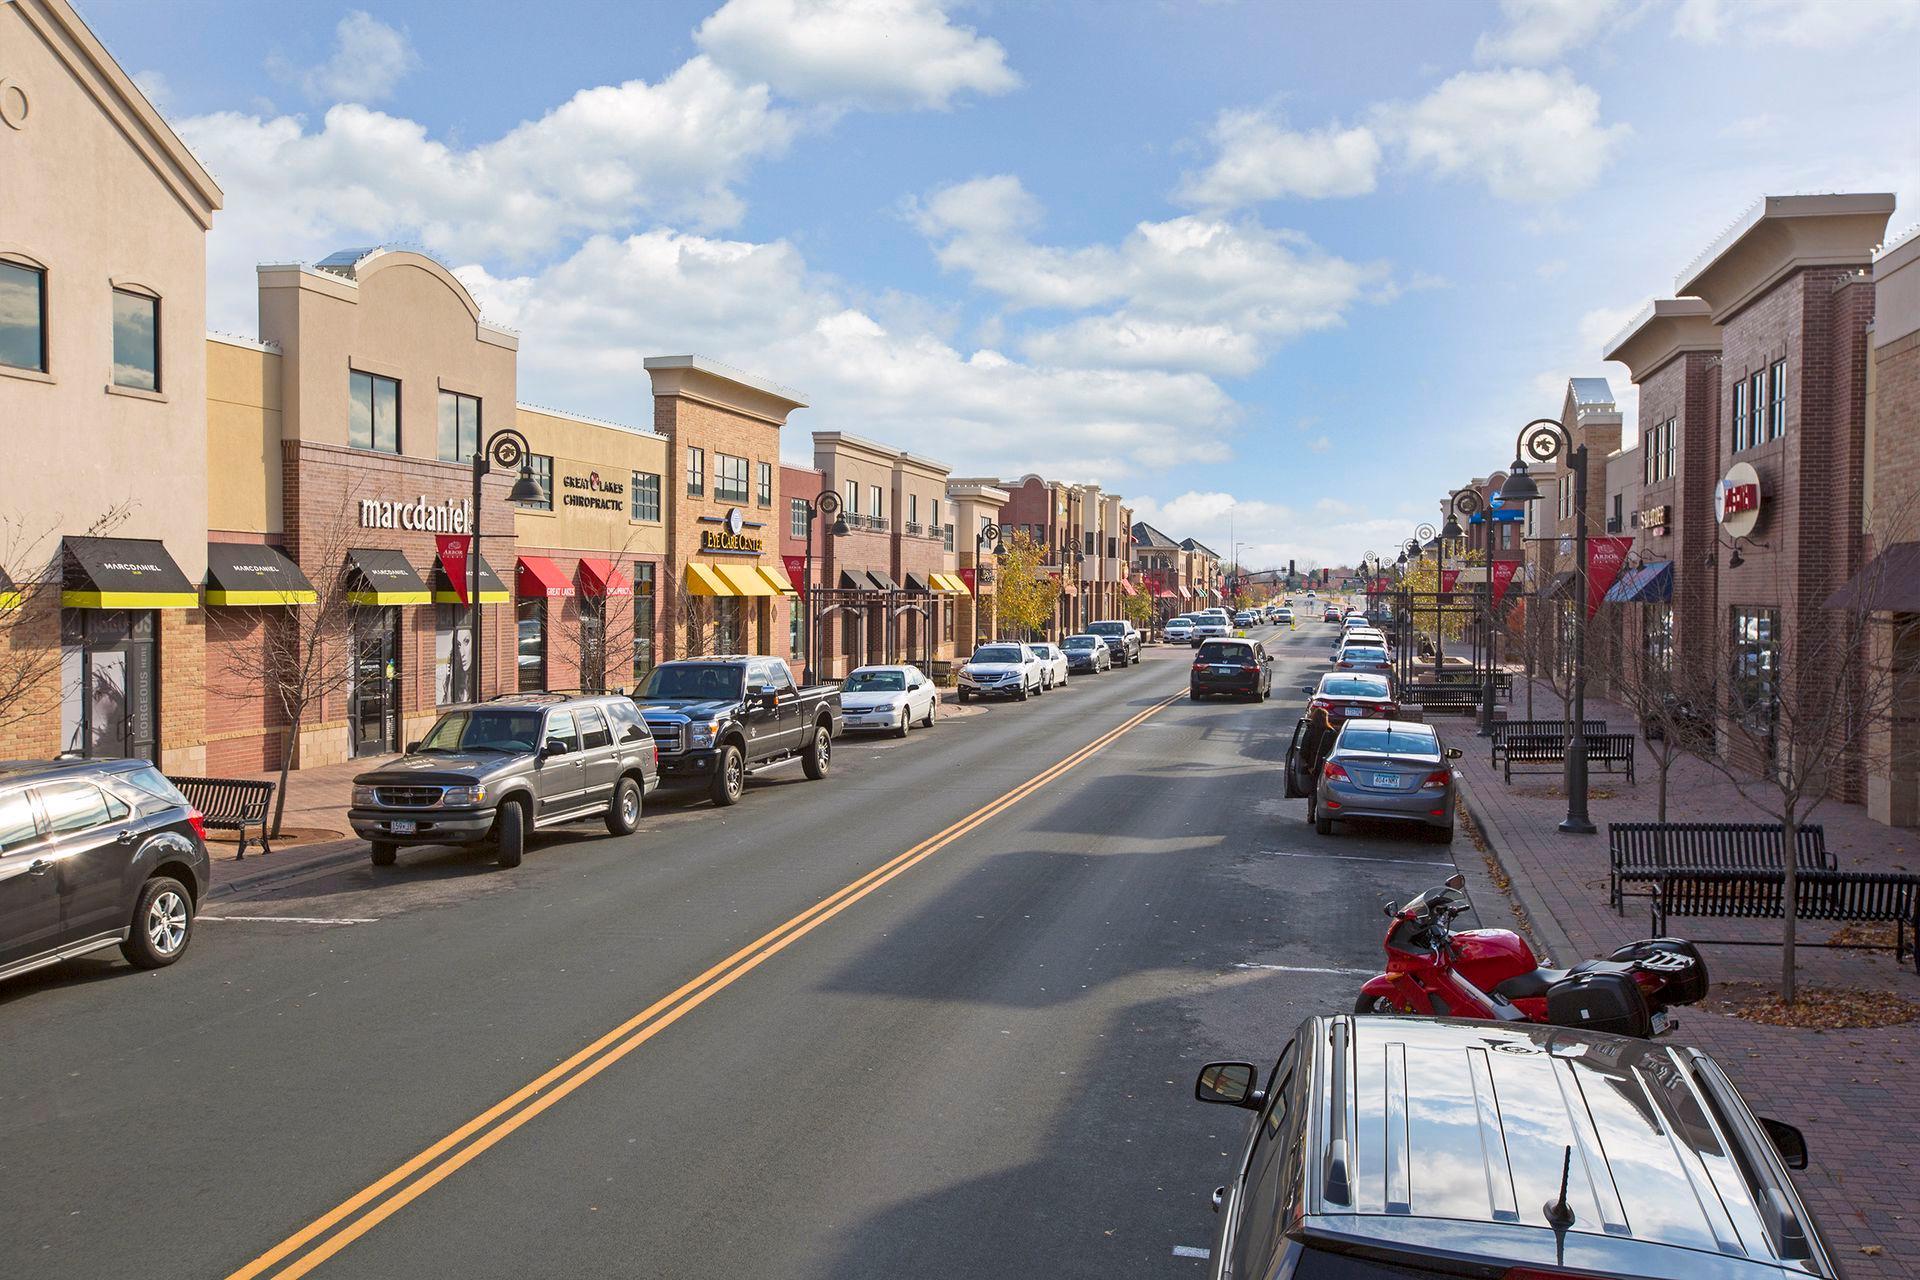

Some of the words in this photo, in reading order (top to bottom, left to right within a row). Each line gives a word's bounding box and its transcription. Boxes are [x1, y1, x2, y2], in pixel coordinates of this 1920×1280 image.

[563, 476, 589, 490] GREAT
[599, 480, 623, 494] LAKES
[563, 494, 623, 511] CHIROPRACTIC
[361, 494, 469, 534] marcdaniel
[103, 562, 162, 572] MARCDANIEL
[140, 671, 149, 739] GORGEOUS
